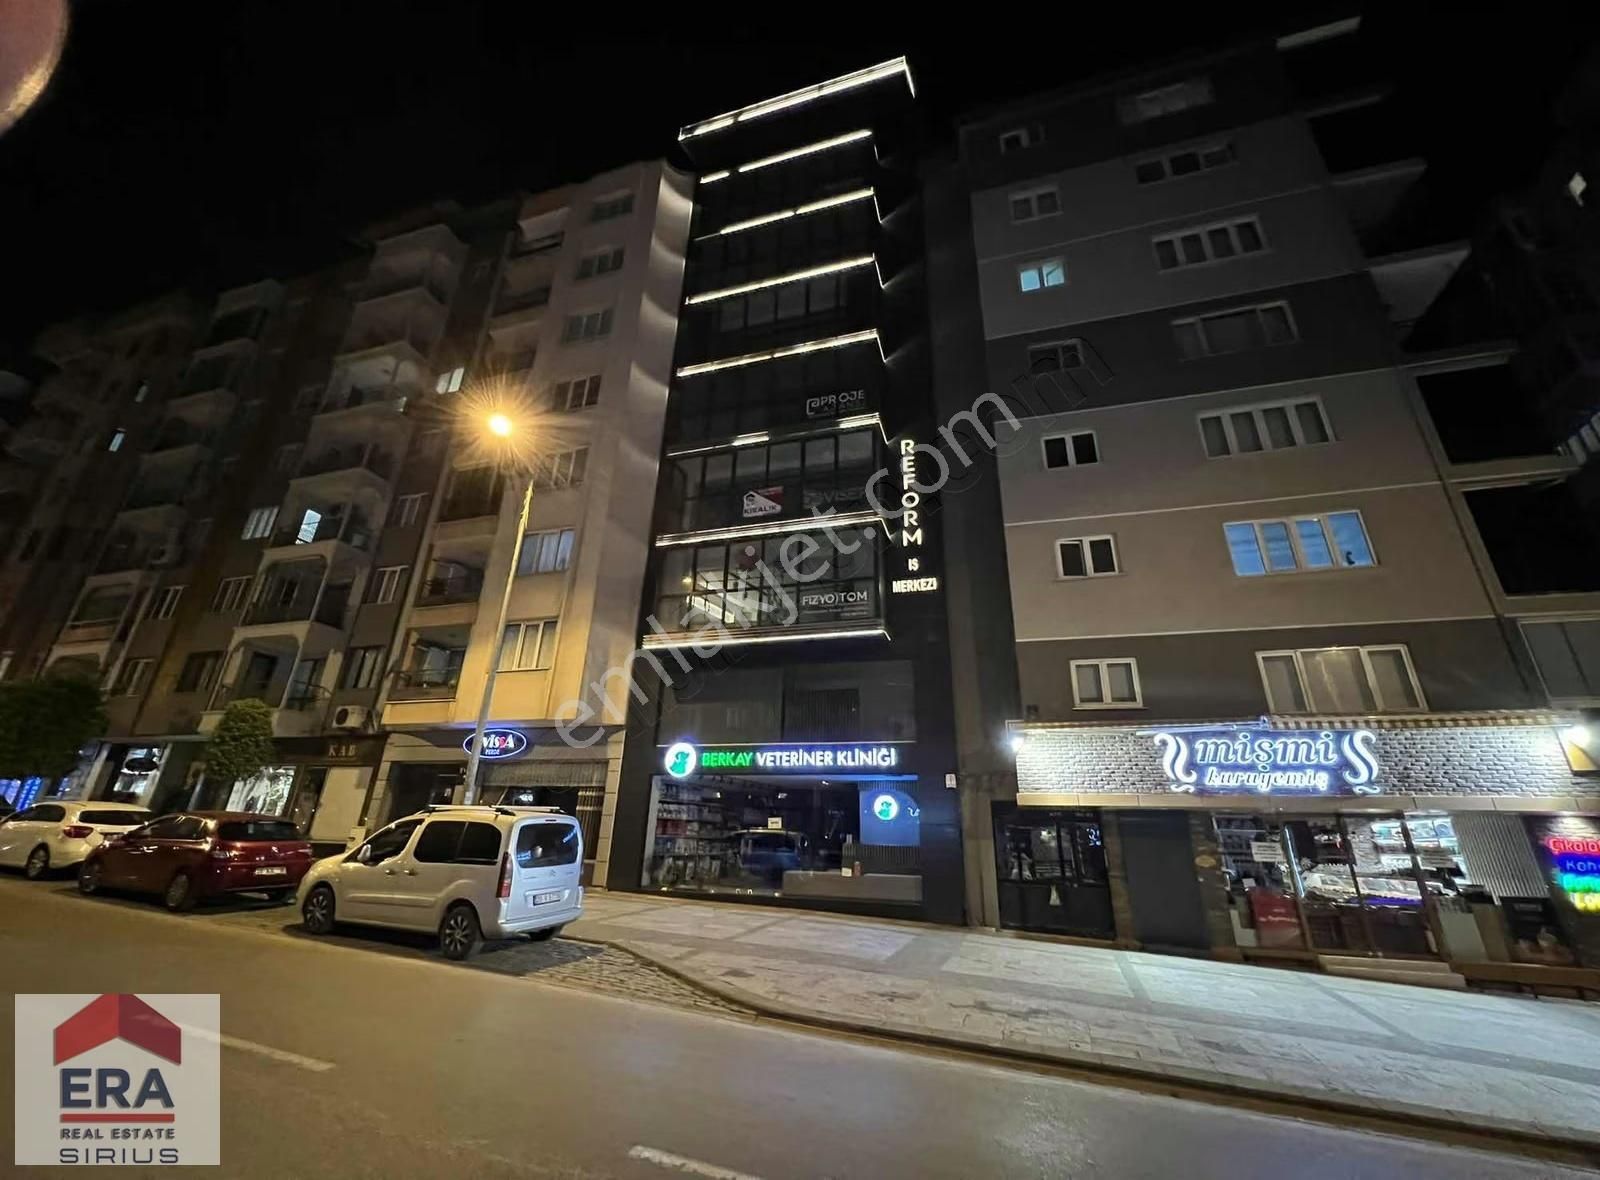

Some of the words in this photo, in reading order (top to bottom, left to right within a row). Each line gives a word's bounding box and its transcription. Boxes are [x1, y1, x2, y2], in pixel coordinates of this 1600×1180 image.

[820, 389, 865, 406] PROJE
[900, 438, 923, 547] REFORM
[702, 752, 753, 767] BERKAY
[757, 749, 833, 767] VETERİNER
[1196, 731, 1337, 771] mişmi
[1206, 767, 1329, 791] kuruyemiş
